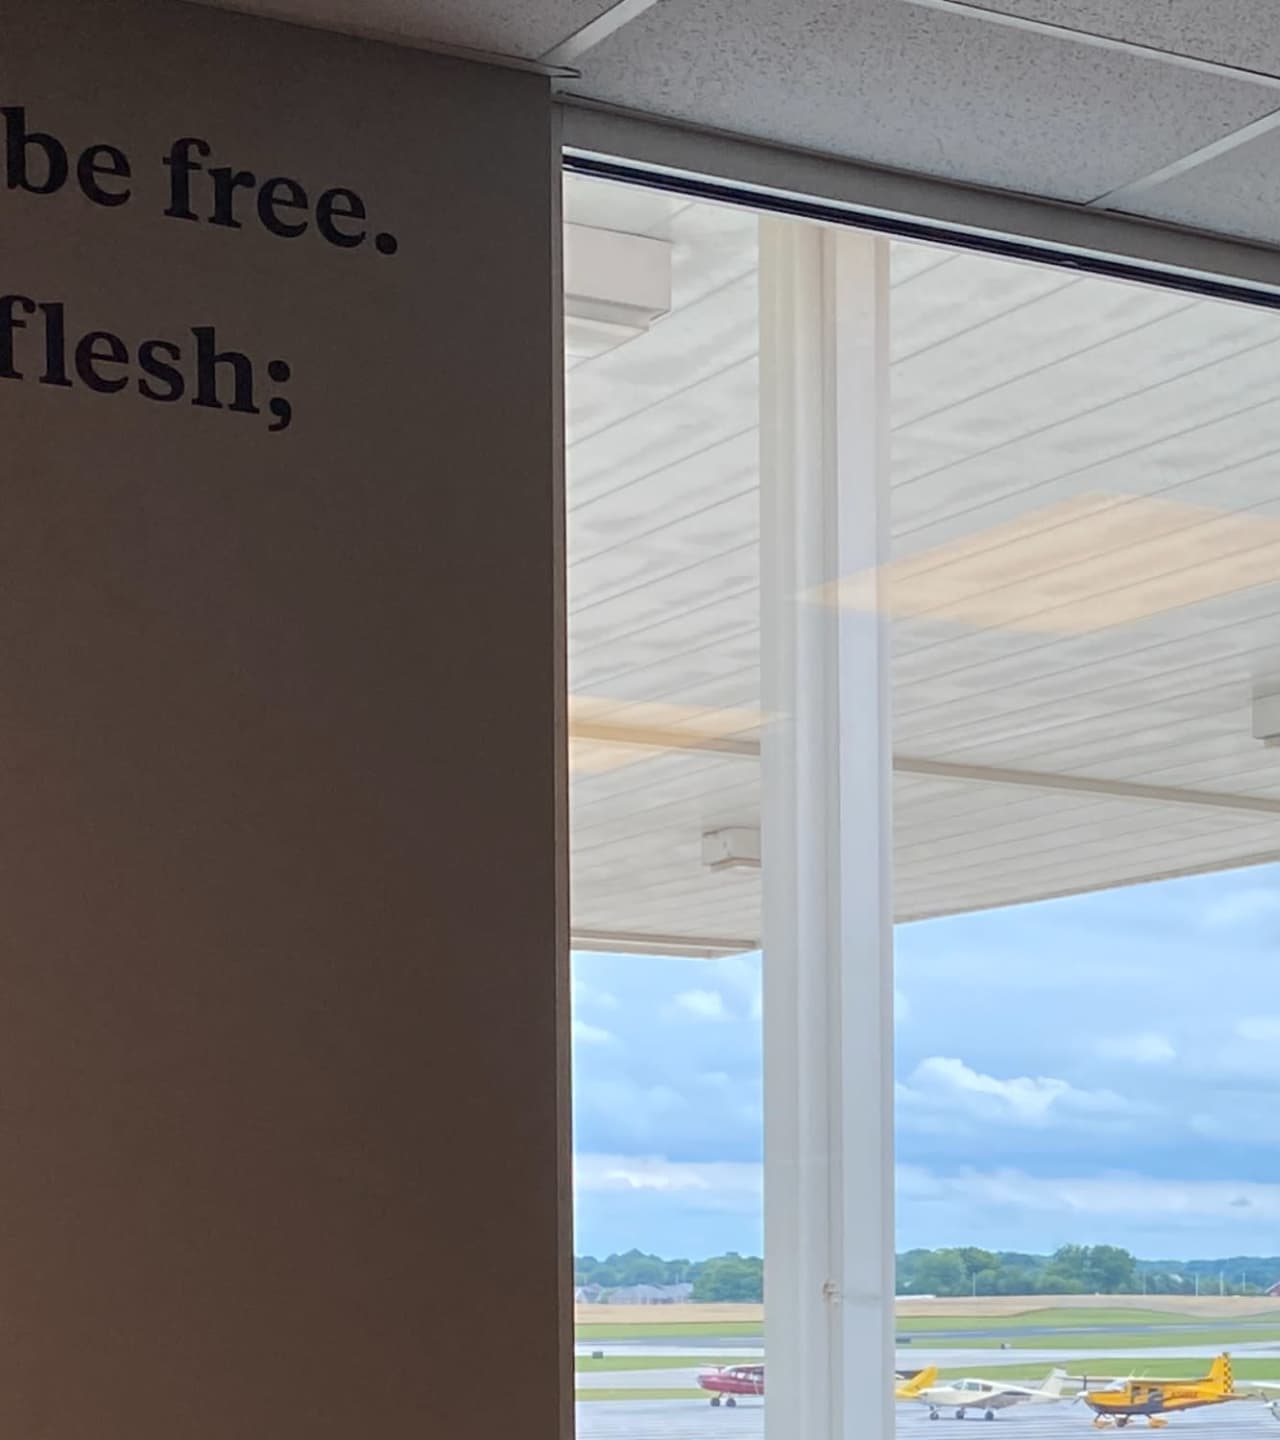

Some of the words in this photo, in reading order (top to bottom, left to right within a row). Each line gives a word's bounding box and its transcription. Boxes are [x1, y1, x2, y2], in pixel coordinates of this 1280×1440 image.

[2, 106, 132, 207] be
[162, 137, 399, 256] free.
[0, 294, 293, 433] flesh;
